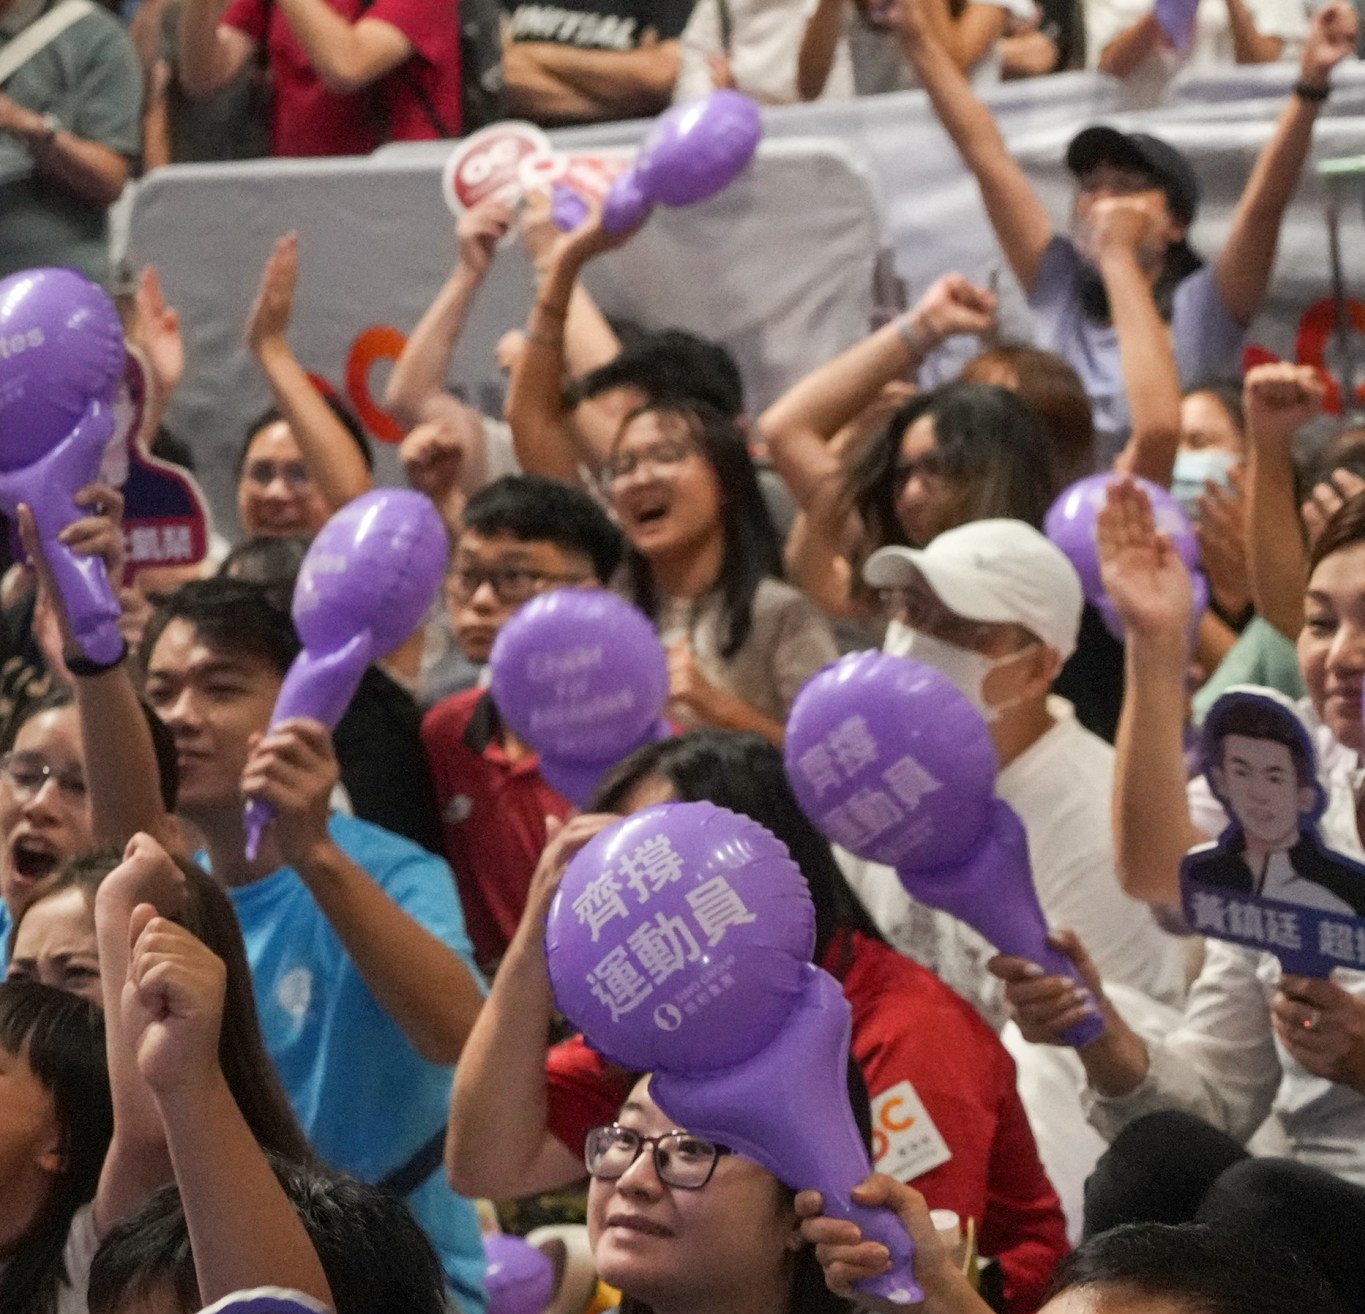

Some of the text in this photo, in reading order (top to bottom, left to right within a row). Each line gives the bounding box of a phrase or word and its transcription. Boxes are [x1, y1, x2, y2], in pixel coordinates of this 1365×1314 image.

[572, 833, 686, 942] 齊撐
[585, 874, 758, 1024] 運動員
